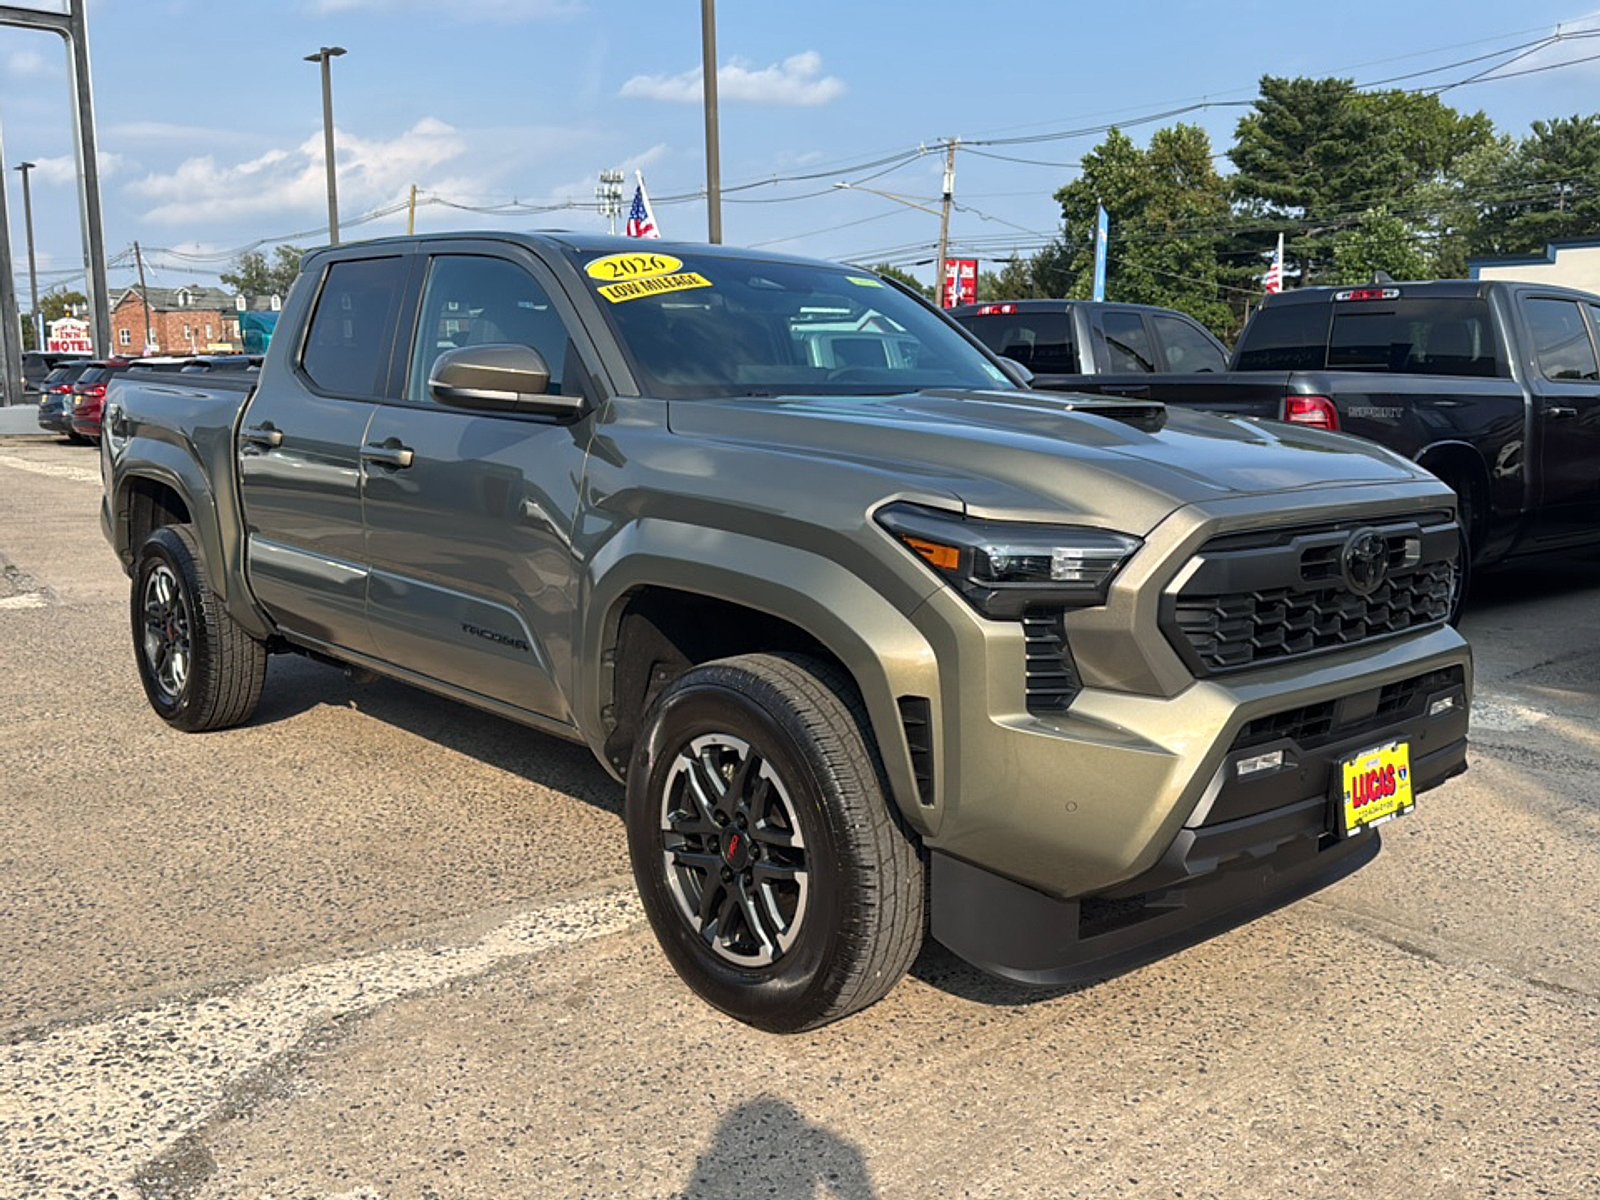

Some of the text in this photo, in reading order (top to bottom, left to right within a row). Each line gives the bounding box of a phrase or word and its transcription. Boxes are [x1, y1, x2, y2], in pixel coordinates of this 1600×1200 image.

[604, 256, 666, 278] 2026
[606, 274, 701, 299] LOW MILEAGE
[50, 340, 94, 352] MOTEL
[1352, 763, 1396, 809] LUCAS
